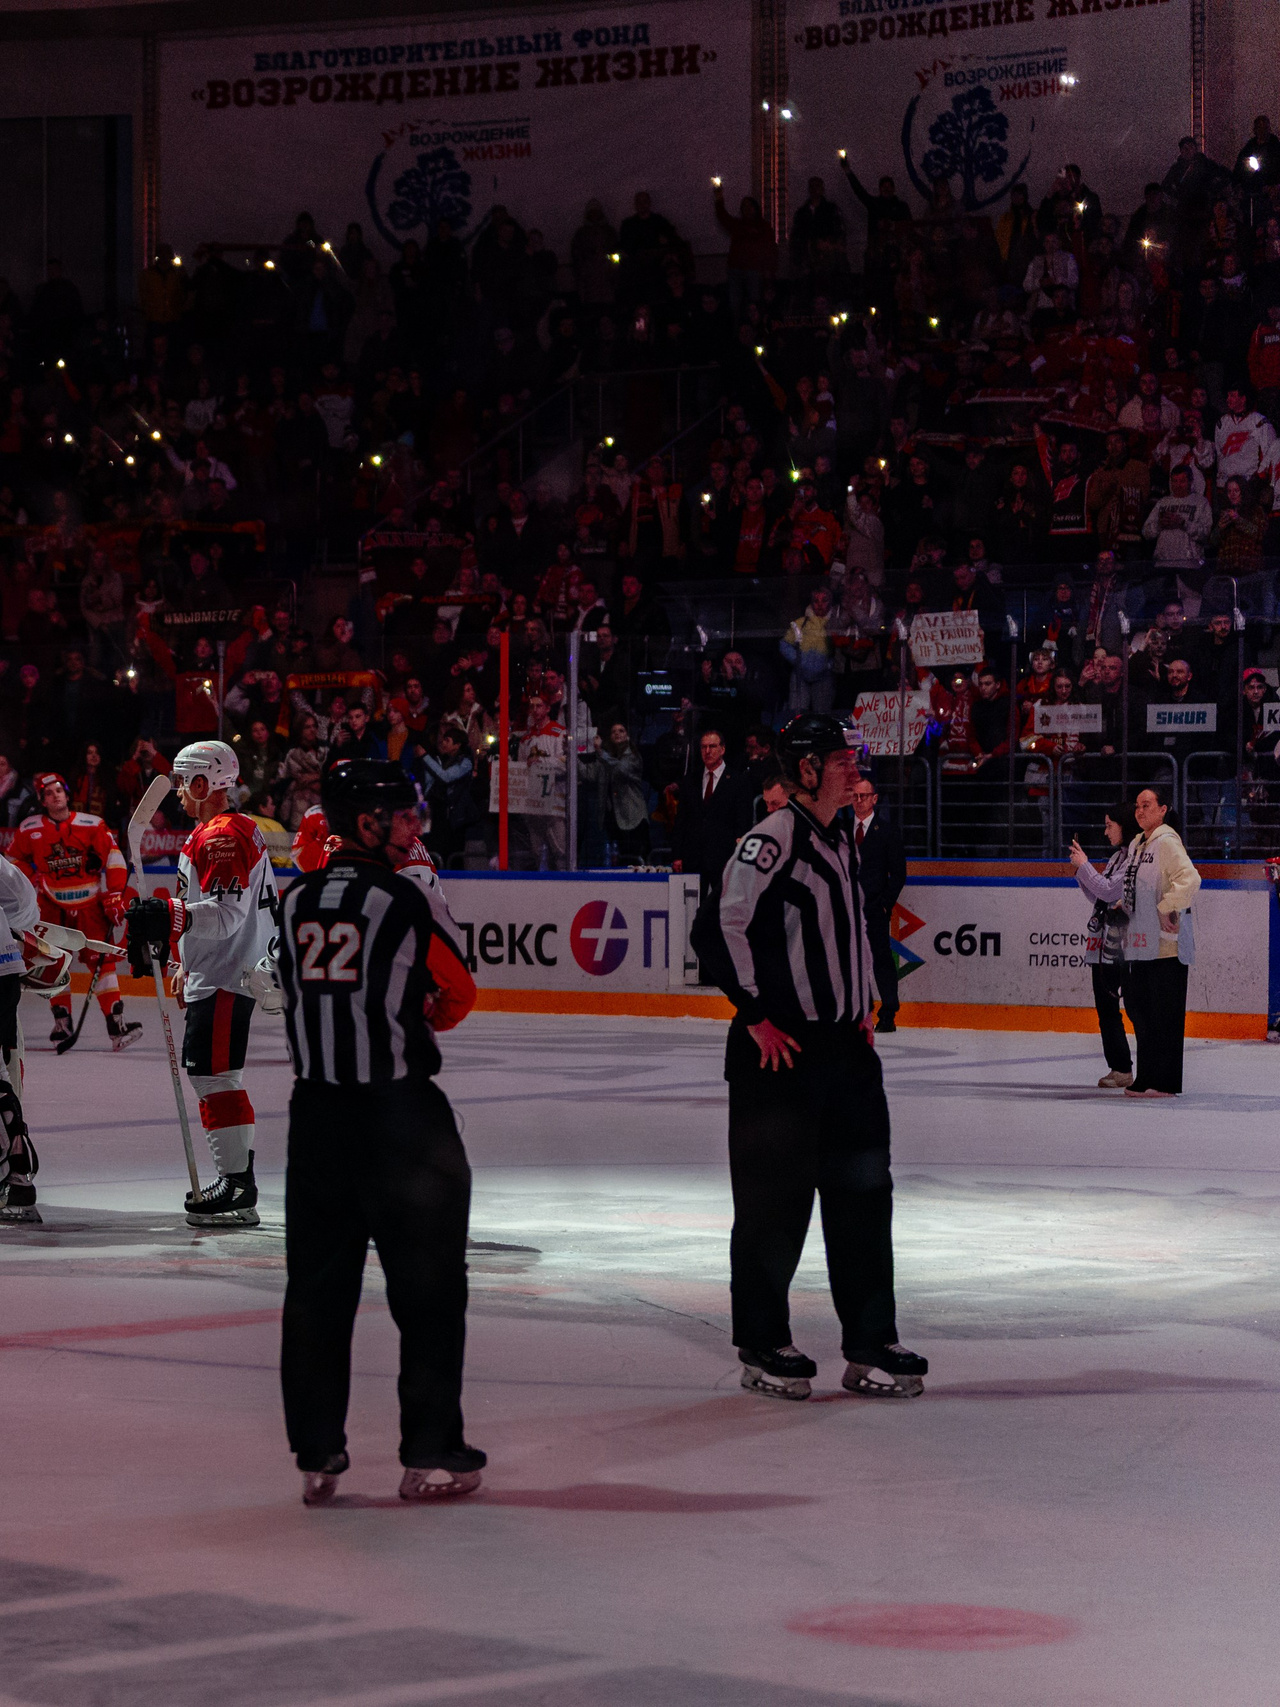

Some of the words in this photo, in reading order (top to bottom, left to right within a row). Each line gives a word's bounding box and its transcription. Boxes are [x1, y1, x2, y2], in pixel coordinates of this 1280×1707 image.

[794, 0, 1034, 50] «ВОЗРОЖДЕНИЕ
[254, 26, 562, 72] БЛАГОТВОРИТЕЛЬНЫЙ
[573, 23, 650, 49] ФОНД
[191, 62, 520, 109] «ВОЗРОЖДЕНИЕ
[535, 44, 717, 89] ЖИЗНИ»
[944, 57, 1068, 88] ВОЗРОЖДЕНИЕ
[999, 77, 1071, 102] ЖИЗНИ
[409, 124, 530, 147] ВОЗРОЖДЕНИЕ
[462, 142, 531, 162] ЖИЗНИ
[860, 693, 880, 712] WE
[1156, 711, 1207, 724] SIBUR
[142, 832, 185, 852] ONBE
[740, 837, 780, 871] 96
[55, 890, 90, 901] SIBUR
[209, 876, 244, 902] 44
[297, 921, 361, 982] 22
[933, 923, 1001, 957] сбп
[1029, 932, 1089, 946] систем
[1029, 953, 1092, 968] платеж
[162, 1011, 179, 1078] JETSPEED
